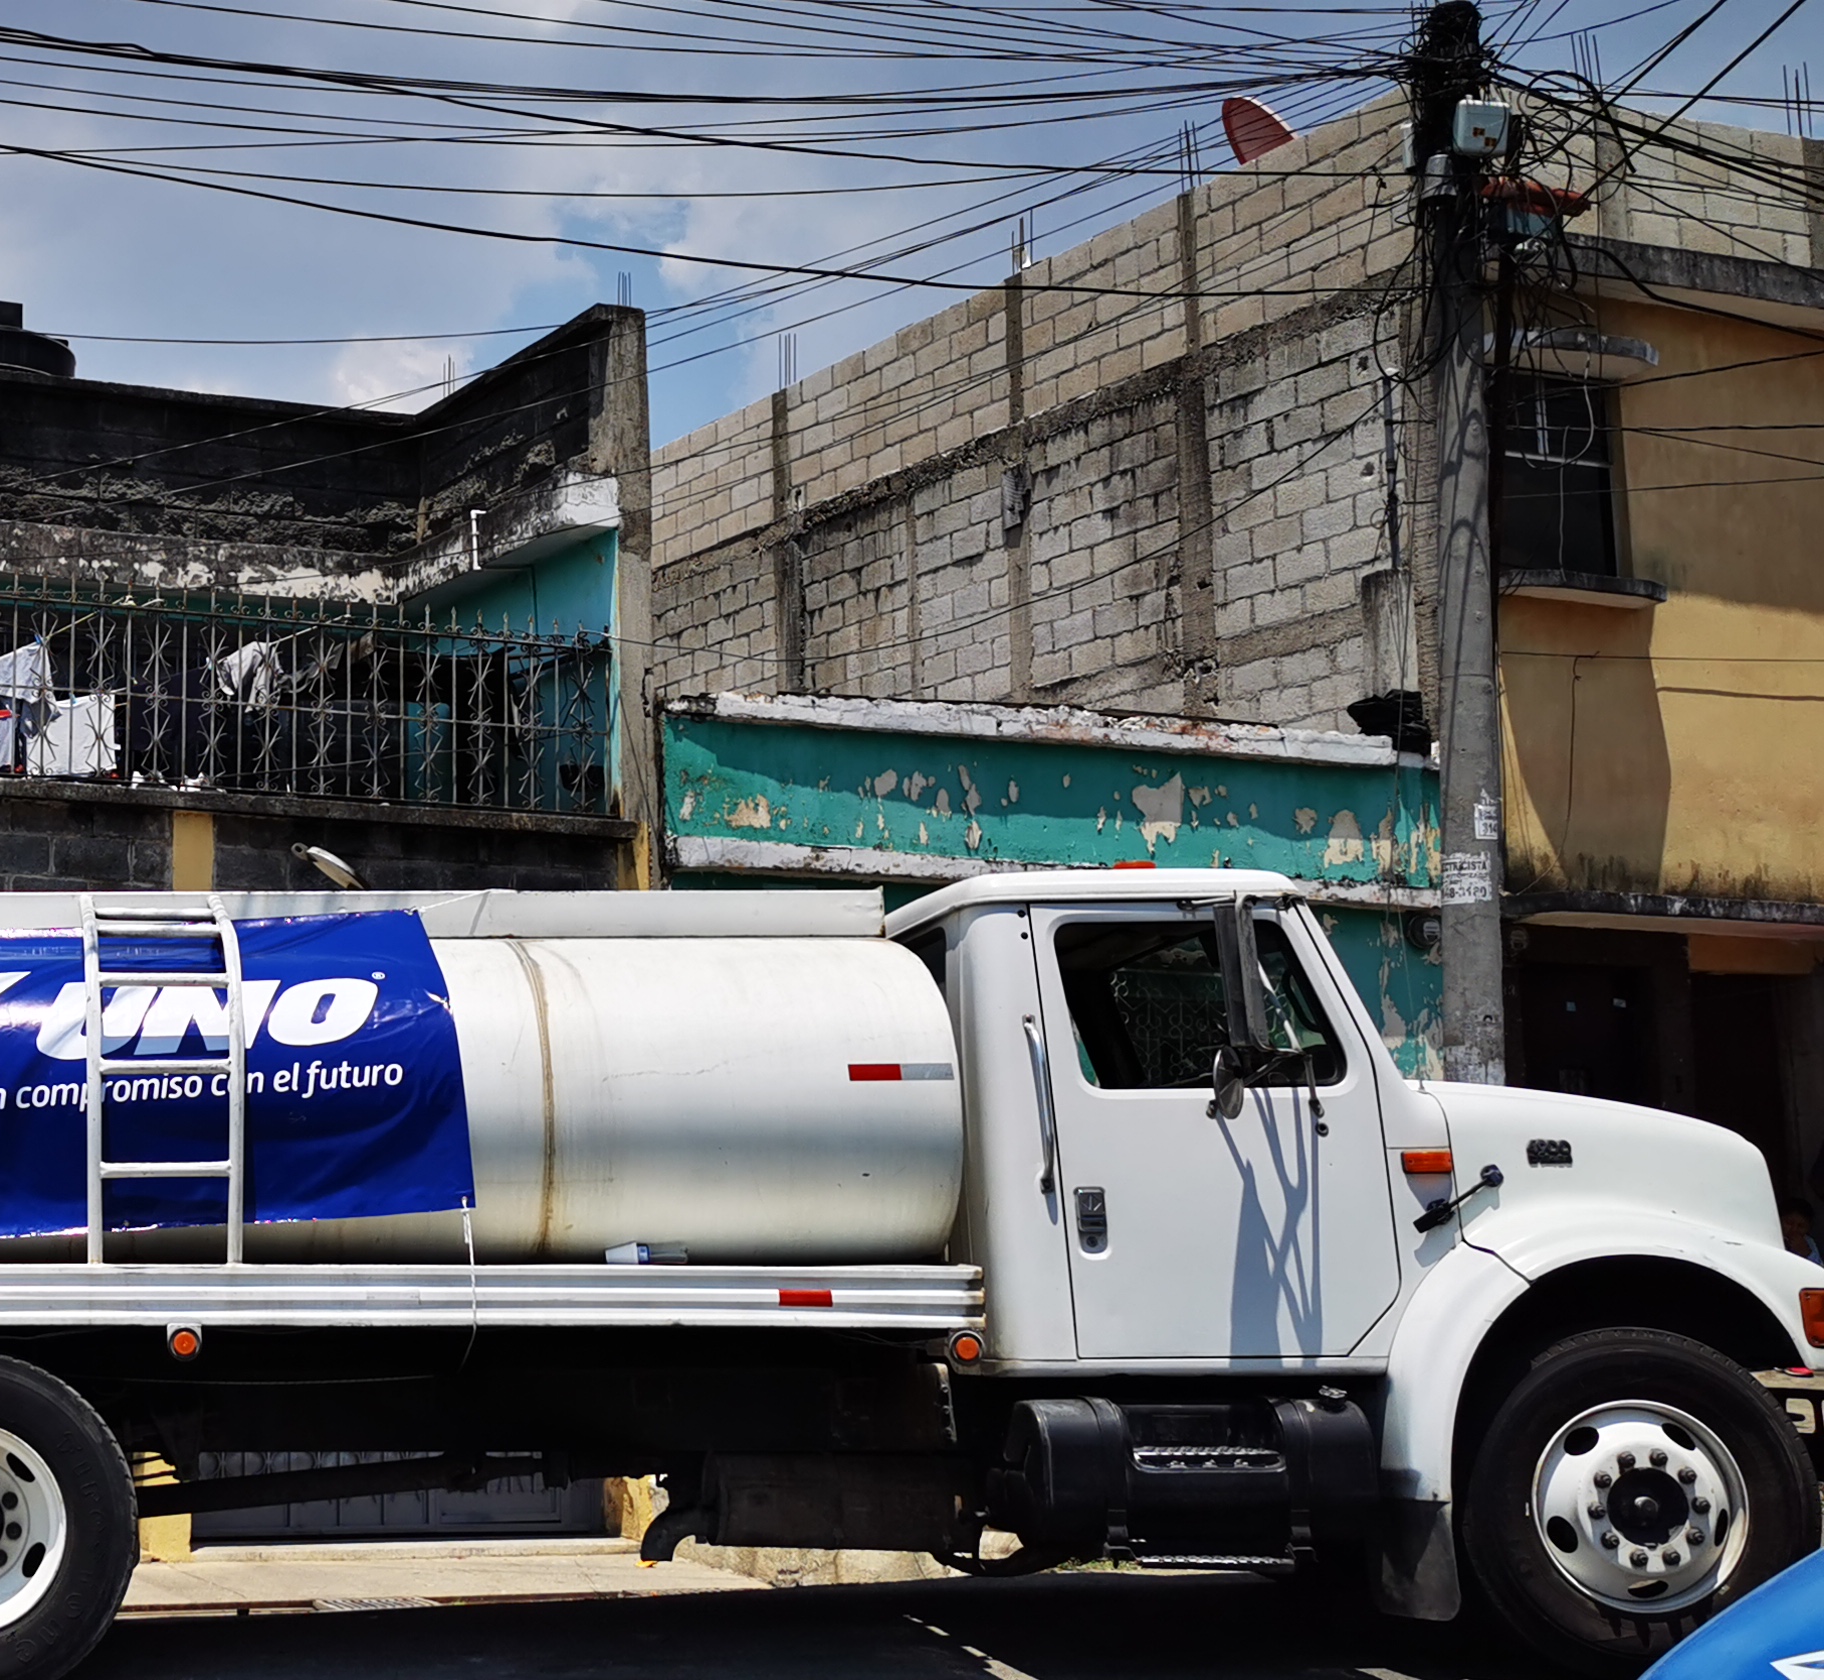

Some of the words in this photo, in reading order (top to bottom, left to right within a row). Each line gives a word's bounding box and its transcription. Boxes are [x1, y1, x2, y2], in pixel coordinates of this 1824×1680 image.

[36, 977, 379, 1061] UNO
[211, 1071, 264, 1096] cn
[273, 1062, 300, 1092] el
[301, 1060, 404, 1099] futuro
